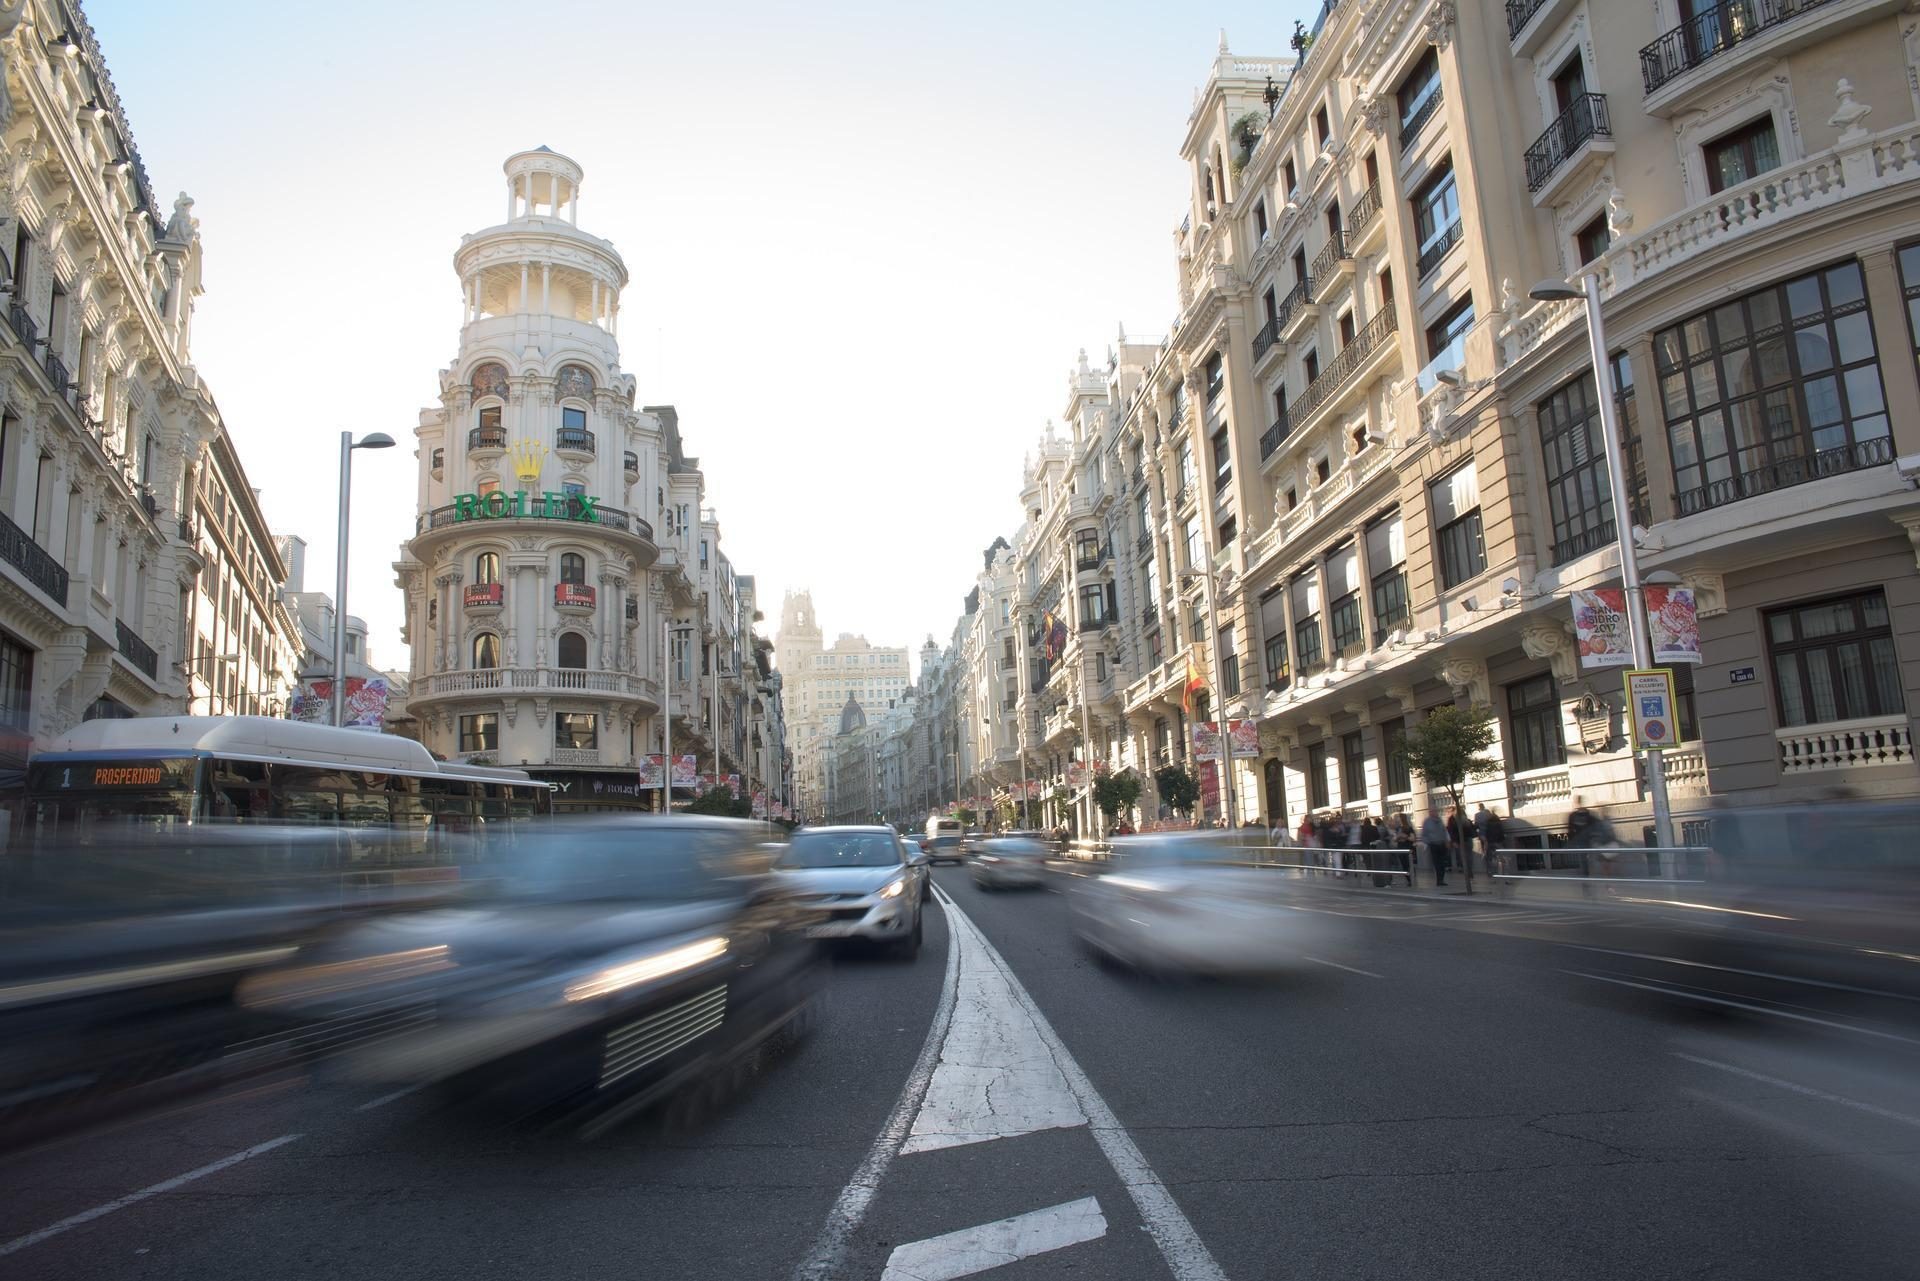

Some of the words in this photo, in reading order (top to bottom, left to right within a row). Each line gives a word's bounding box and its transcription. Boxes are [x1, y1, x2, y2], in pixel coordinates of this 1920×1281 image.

[453, 489, 600, 523] ROLEX
[1592, 606, 1612, 614] SAN
[1587, 614, 1620, 624] ISIDRO
[1594, 624, 1616, 633] 2017
[61, 767, 70, 788] 1
[95, 767, 161, 785] PROSPERIDAD
